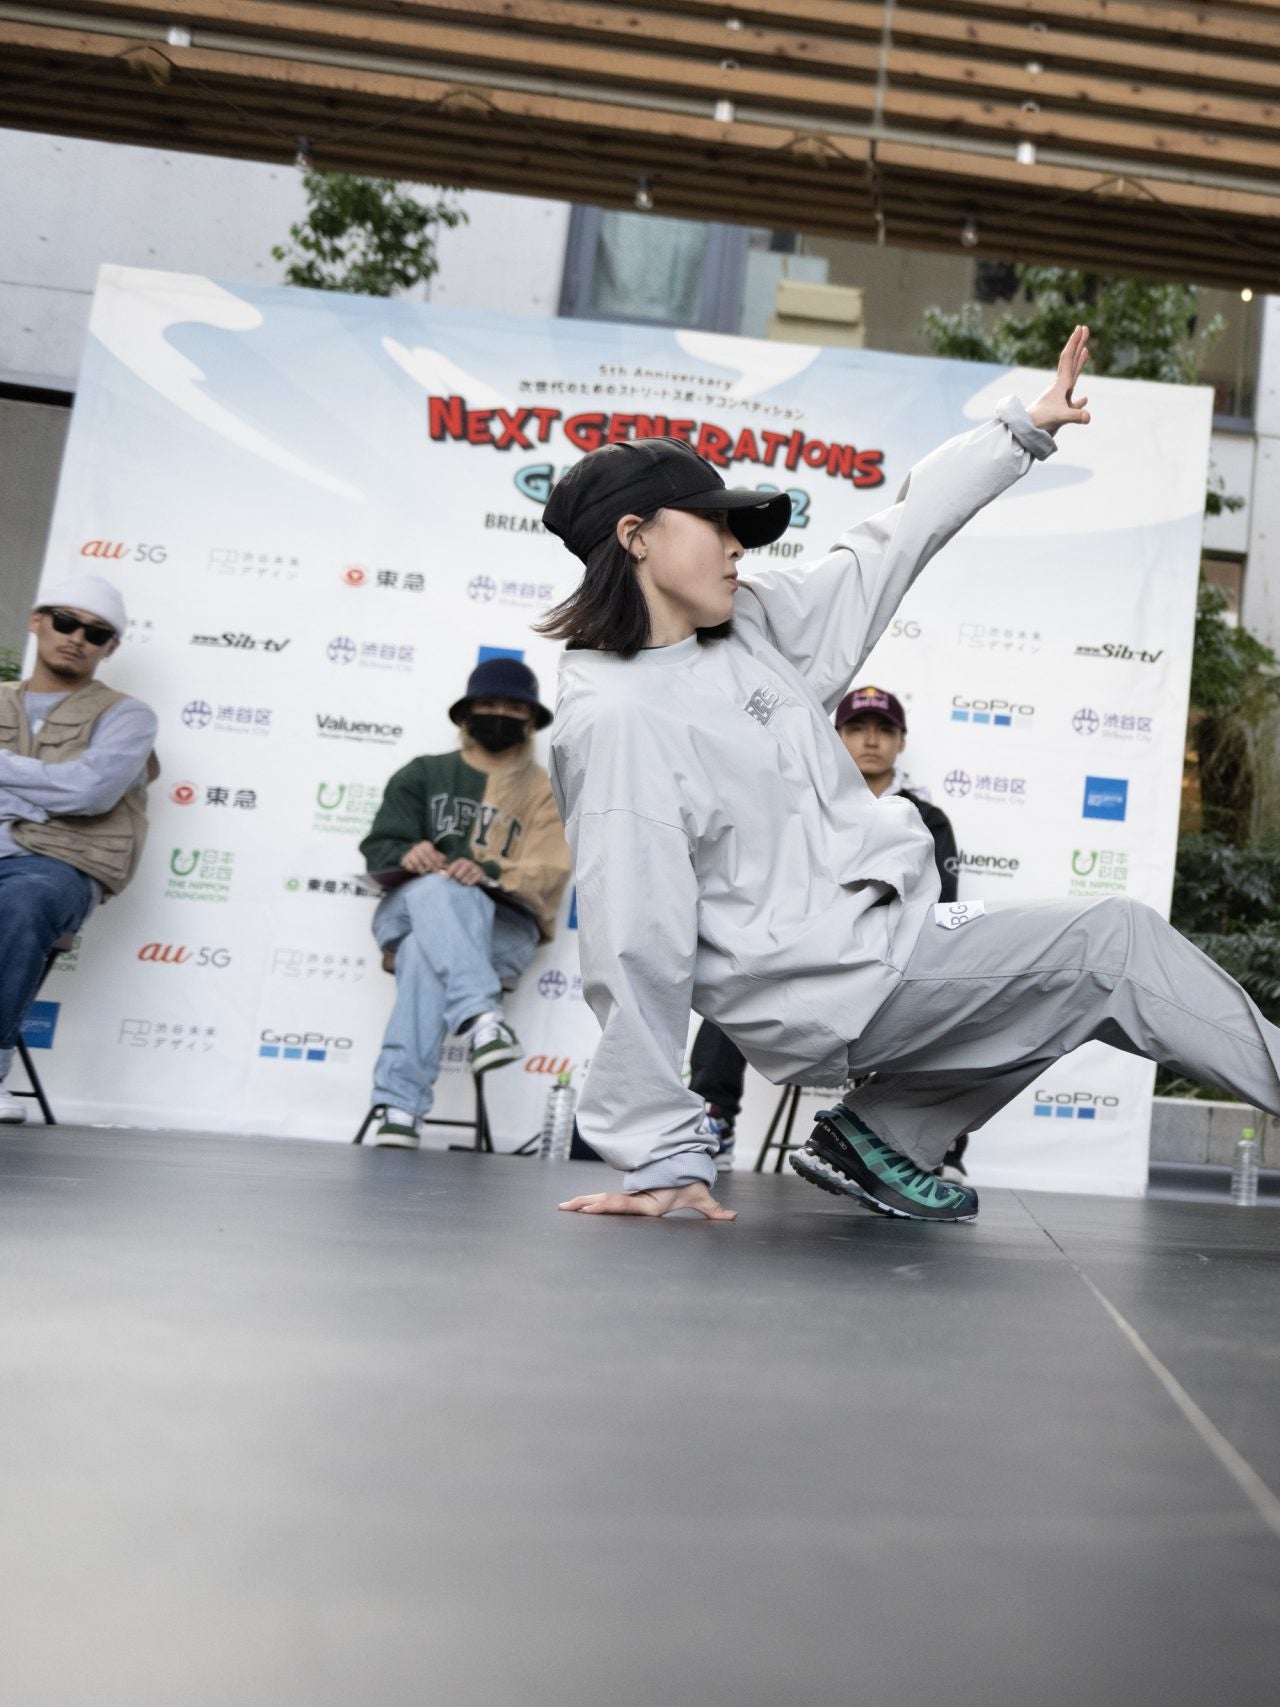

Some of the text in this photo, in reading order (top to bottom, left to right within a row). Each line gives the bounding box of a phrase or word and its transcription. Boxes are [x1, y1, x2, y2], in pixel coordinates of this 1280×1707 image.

[599, 365, 735, 391] 5th Anniversary
[428, 396, 562, 450] NEXT
[564, 411, 886, 488] GENERATIONS
[80, 540, 167, 564] au 5G
[377, 570, 426, 592] 東急
[891, 619, 922, 640] 5G
[217, 705, 272, 727] 渋谷区
[952, 695, 1035, 716] GoPro
[316, 713, 403, 738] Valuence
[1103, 711, 1153, 733] 渋谷区
[975, 774, 1027, 795] 渋谷区
[205, 785, 257, 809] 東急
[957, 850, 1020, 871] luence
[137, 942, 232, 968] au 5G
[260, 1029, 354, 1050] GoPro
[524, 1054, 577, 1075] au
[1034, 1090, 1119, 1107] GoPro
